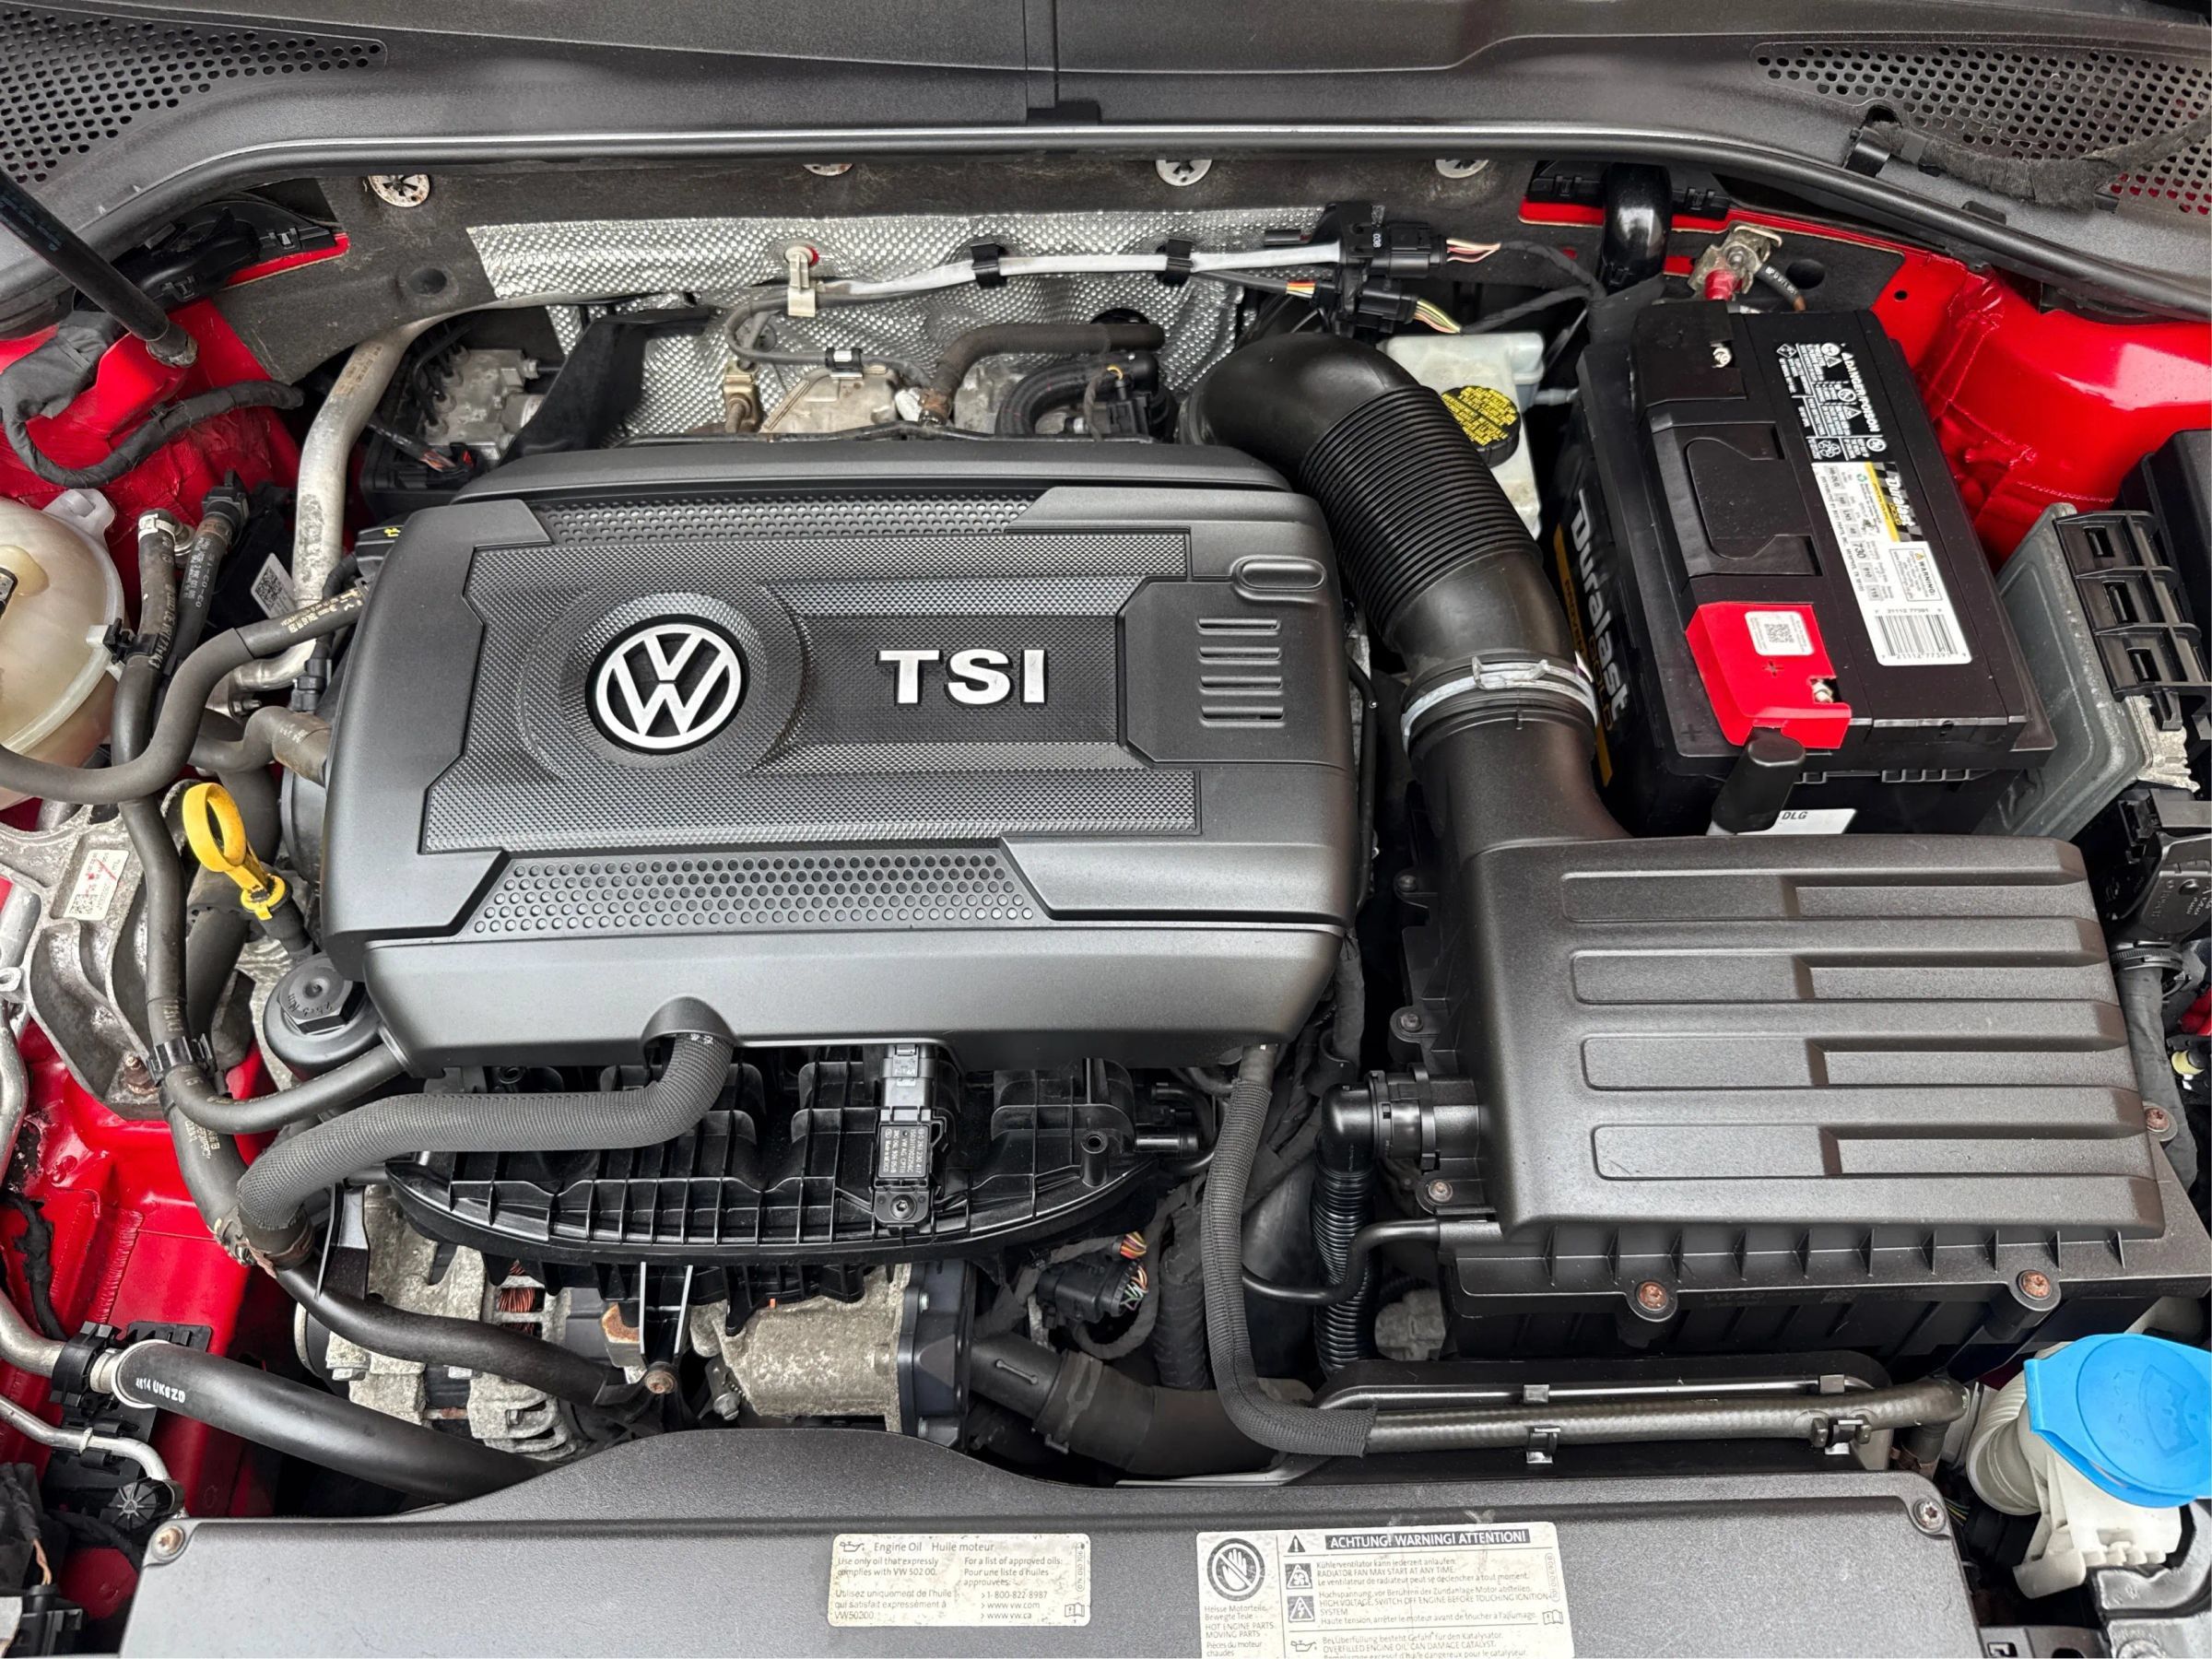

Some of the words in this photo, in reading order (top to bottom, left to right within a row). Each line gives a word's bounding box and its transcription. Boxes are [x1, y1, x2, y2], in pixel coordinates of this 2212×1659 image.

[1843, 359, 1880, 432] DANGER/POISON
[1885, 475, 1915, 529] Duralast
[1853, 542, 1866, 559] 730
[1571, 488, 1629, 722] Duralast
[877, 648, 1050, 705] TSI
[1331, 1535, 1392, 1547] ACHTUNG!
[1395, 1534, 1455, 1546] WARNING!
[1459, 1530, 1525, 1544] ATTENTION!
[874, 1542, 906, 1554] Engine
[909, 1542, 923, 1551] Oil
[932, 1543, 957, 1551] Huile
[959, 1543, 994, 1551] moteur
[854, 1557, 871, 1567] only
[873, 1557, 882, 1565] oil
[902, 1557, 938, 1567] expressly
[964, 1557, 976, 1565] For
[985, 1557, 997, 1565] list
[999, 1557, 1007, 1565] of
[1009, 1557, 1045, 1567] approved
[1047, 1557, 1063, 1565] oils:
[1317, 1560, 1372, 1569] Kühlerventilator
[838, 1569, 871, 1578] complies
[1001, 1568, 1018, 1576] liste
[1019, 1568, 1049, 1576] d'huiles
[1327, 1577, 1364, 1585] ventilateur
[1376, 1577, 1408, 1585] radiateur
[1410, 1577, 1426, 1585] peut
[1375, 1597, 1402, 1606] SWITCH
[1404, 1596, 1417, 1605] OFF
[1418, 1596, 1445, 1605] ENGINE
[1206, 1614, 1235, 1622] Bewegte
[1407, 1633, 1431, 1641] Gefahr
[1323, 1644, 1365, 1653] OVERFILLED
[1367, 1643, 1393, 1652] ENGINE
[1428, 1641, 1459, 1650] DAMAGE
[1206, 1649, 1234, 1657] chaudes
